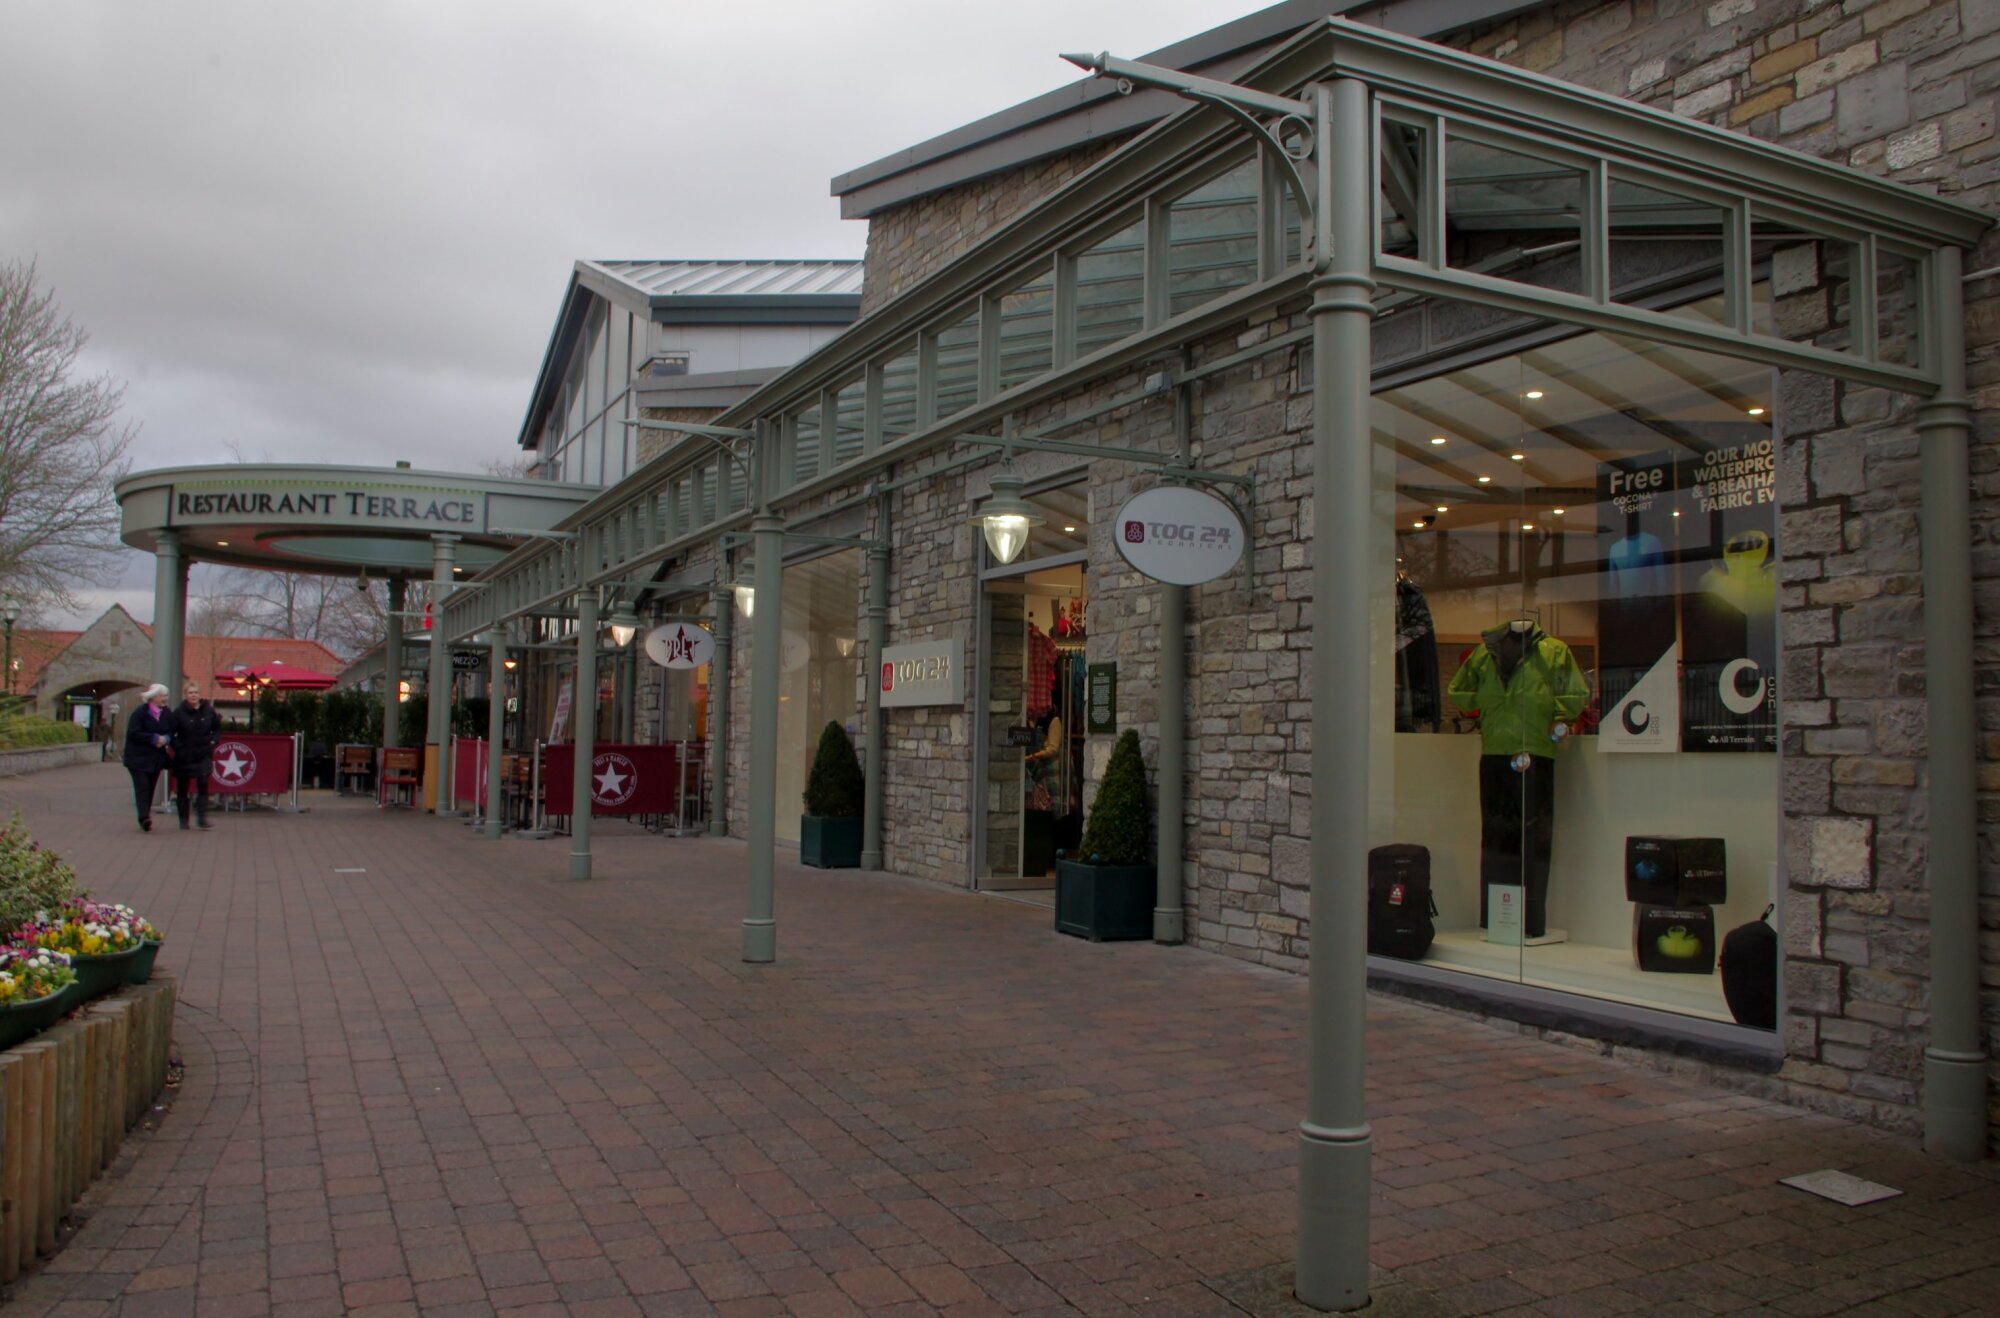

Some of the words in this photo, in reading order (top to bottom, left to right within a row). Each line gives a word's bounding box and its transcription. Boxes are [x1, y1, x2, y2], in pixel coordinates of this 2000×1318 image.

[1704, 446, 1738, 465] OUR
[1743, 439, 1774, 458] MO
[1610, 467, 1663, 494] Free
[1694, 454, 1774, 482] WATERPRO
[1692, 484, 1704, 499] &
[1708, 470, 1774, 496] BREATHA
[178, 493, 336, 516] RESTAURANT
[345, 491, 474, 523] TERRACE
[1619, 501, 1653, 515] T-SHIRT
[1700, 490, 1752, 513] FABRIC
[1147, 522, 1195, 541] TOG
[1200, 525, 1231, 544] 24
[664, 635, 697, 659] PRET
[895, 658, 926, 683] TOG
[928, 655, 951, 680] 24
[1720, 735, 1729, 744] All
[1729, 735, 1756, 744] Terrain
